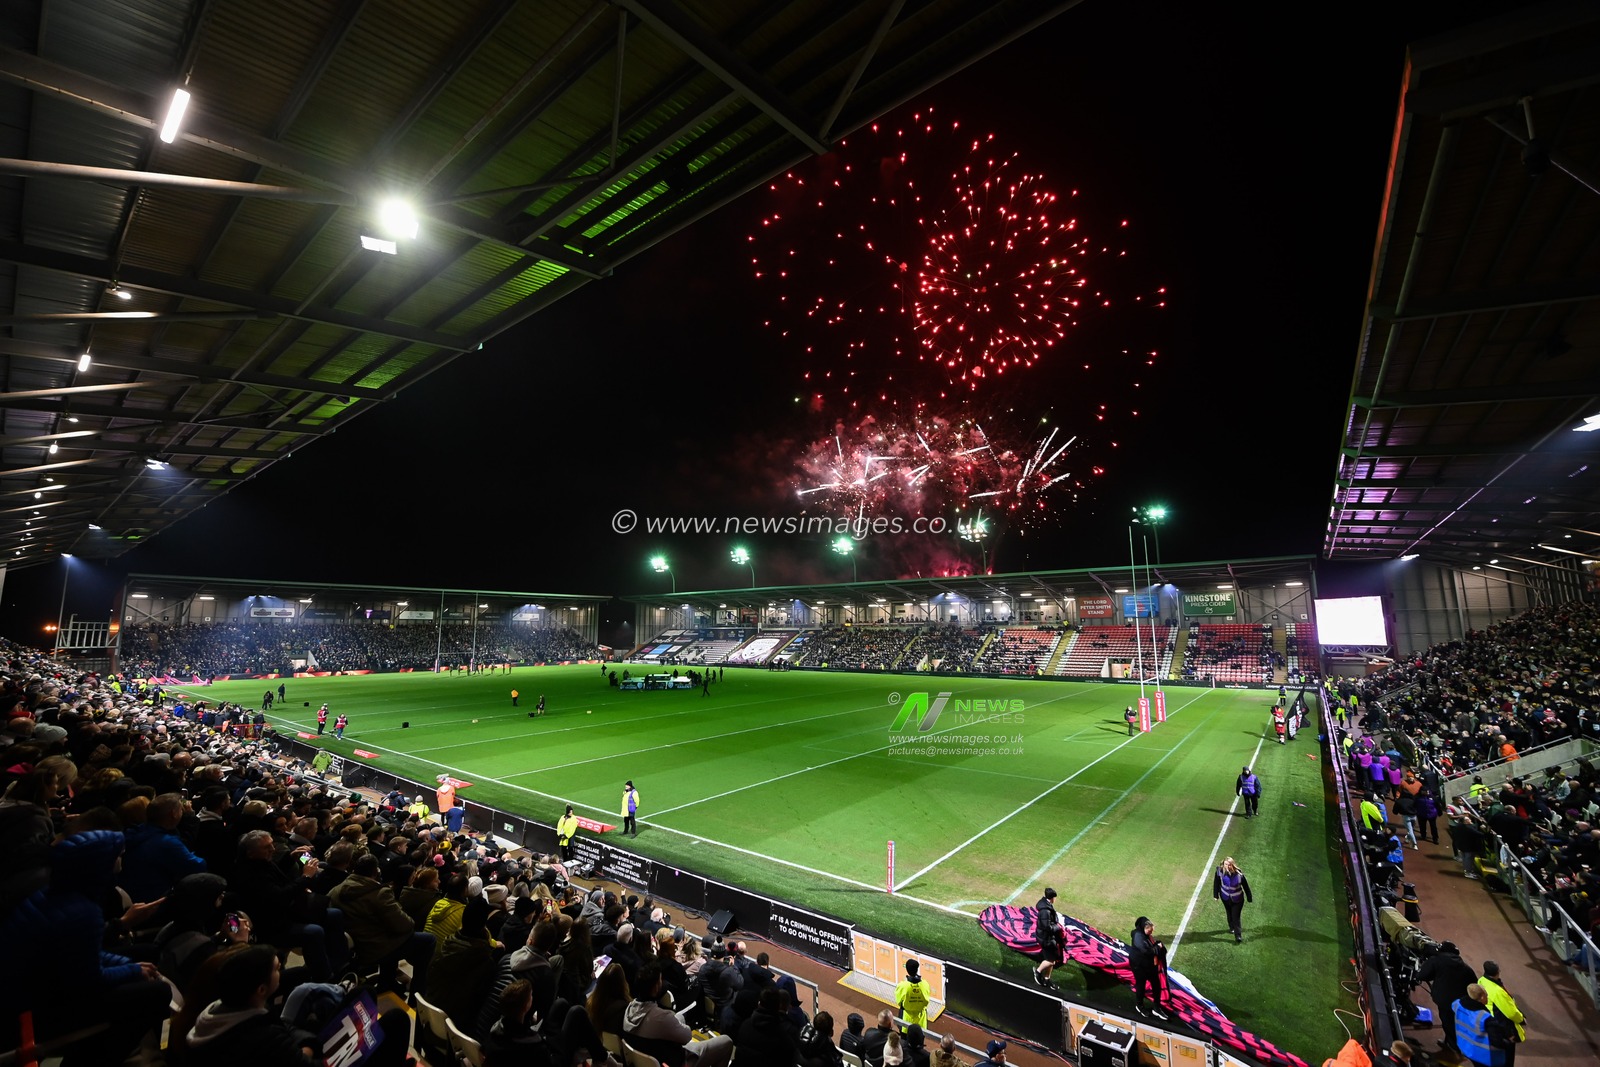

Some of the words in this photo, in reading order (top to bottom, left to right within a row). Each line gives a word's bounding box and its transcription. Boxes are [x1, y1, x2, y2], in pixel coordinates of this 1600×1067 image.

[1185, 594, 1231, 602] KINGSTONE
[586, 845, 599, 854] VILLAGE
[778, 916, 784, 924] IS
[790, 920, 818, 935] CRIMINAL
[779, 925, 787, 933] TO
[788, 928, 797, 936] GO
[798, 932, 807, 940] ON
[808, 935, 820, 945] THE
[821, 939, 839, 951] PITCH
